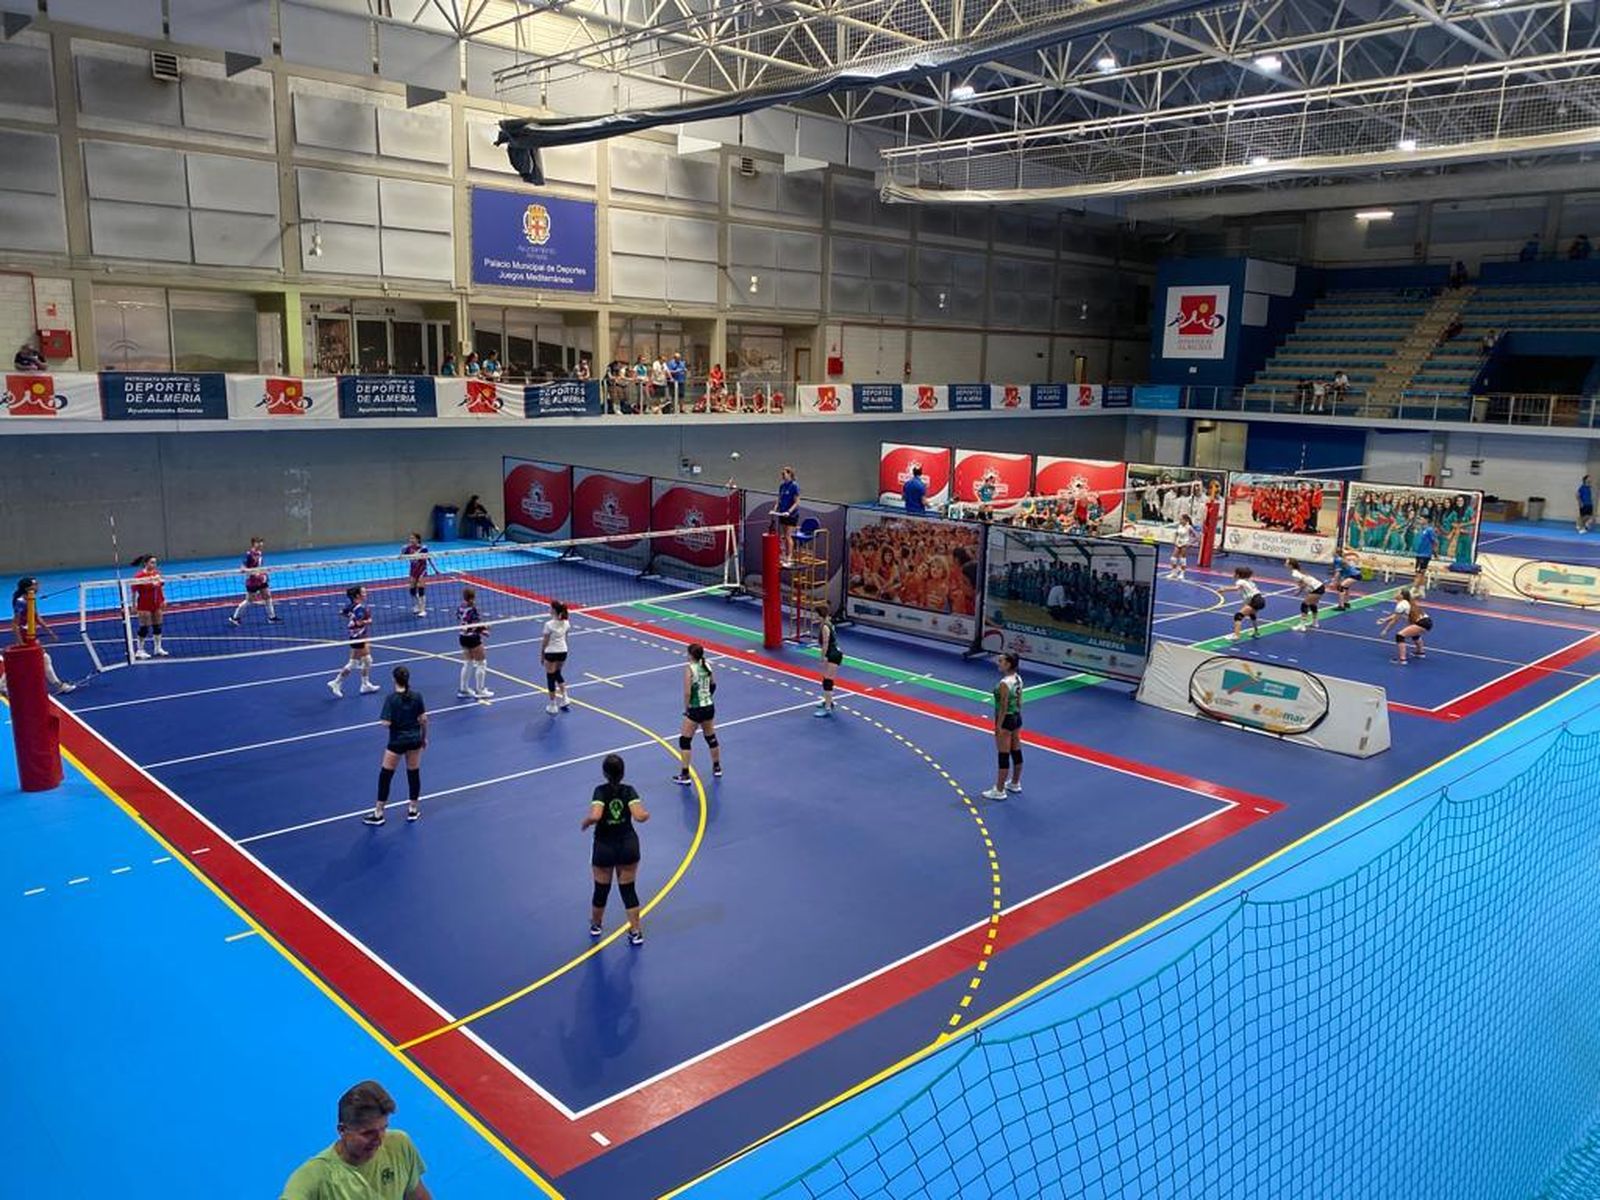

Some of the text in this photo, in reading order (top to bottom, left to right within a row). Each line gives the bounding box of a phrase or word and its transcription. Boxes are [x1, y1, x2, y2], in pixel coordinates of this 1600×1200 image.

[483, 258, 587, 276] Palacio Municipal de Deportes
[499, 271, 524, 281] Juegos
[124, 382, 201, 392] DEPORTES
[356, 384, 416, 393] DEPORTES
[539, 386, 586, 396] DEPORTES
[126, 393, 202, 403] DE ALMERIA
[357, 394, 372, 403] DE
